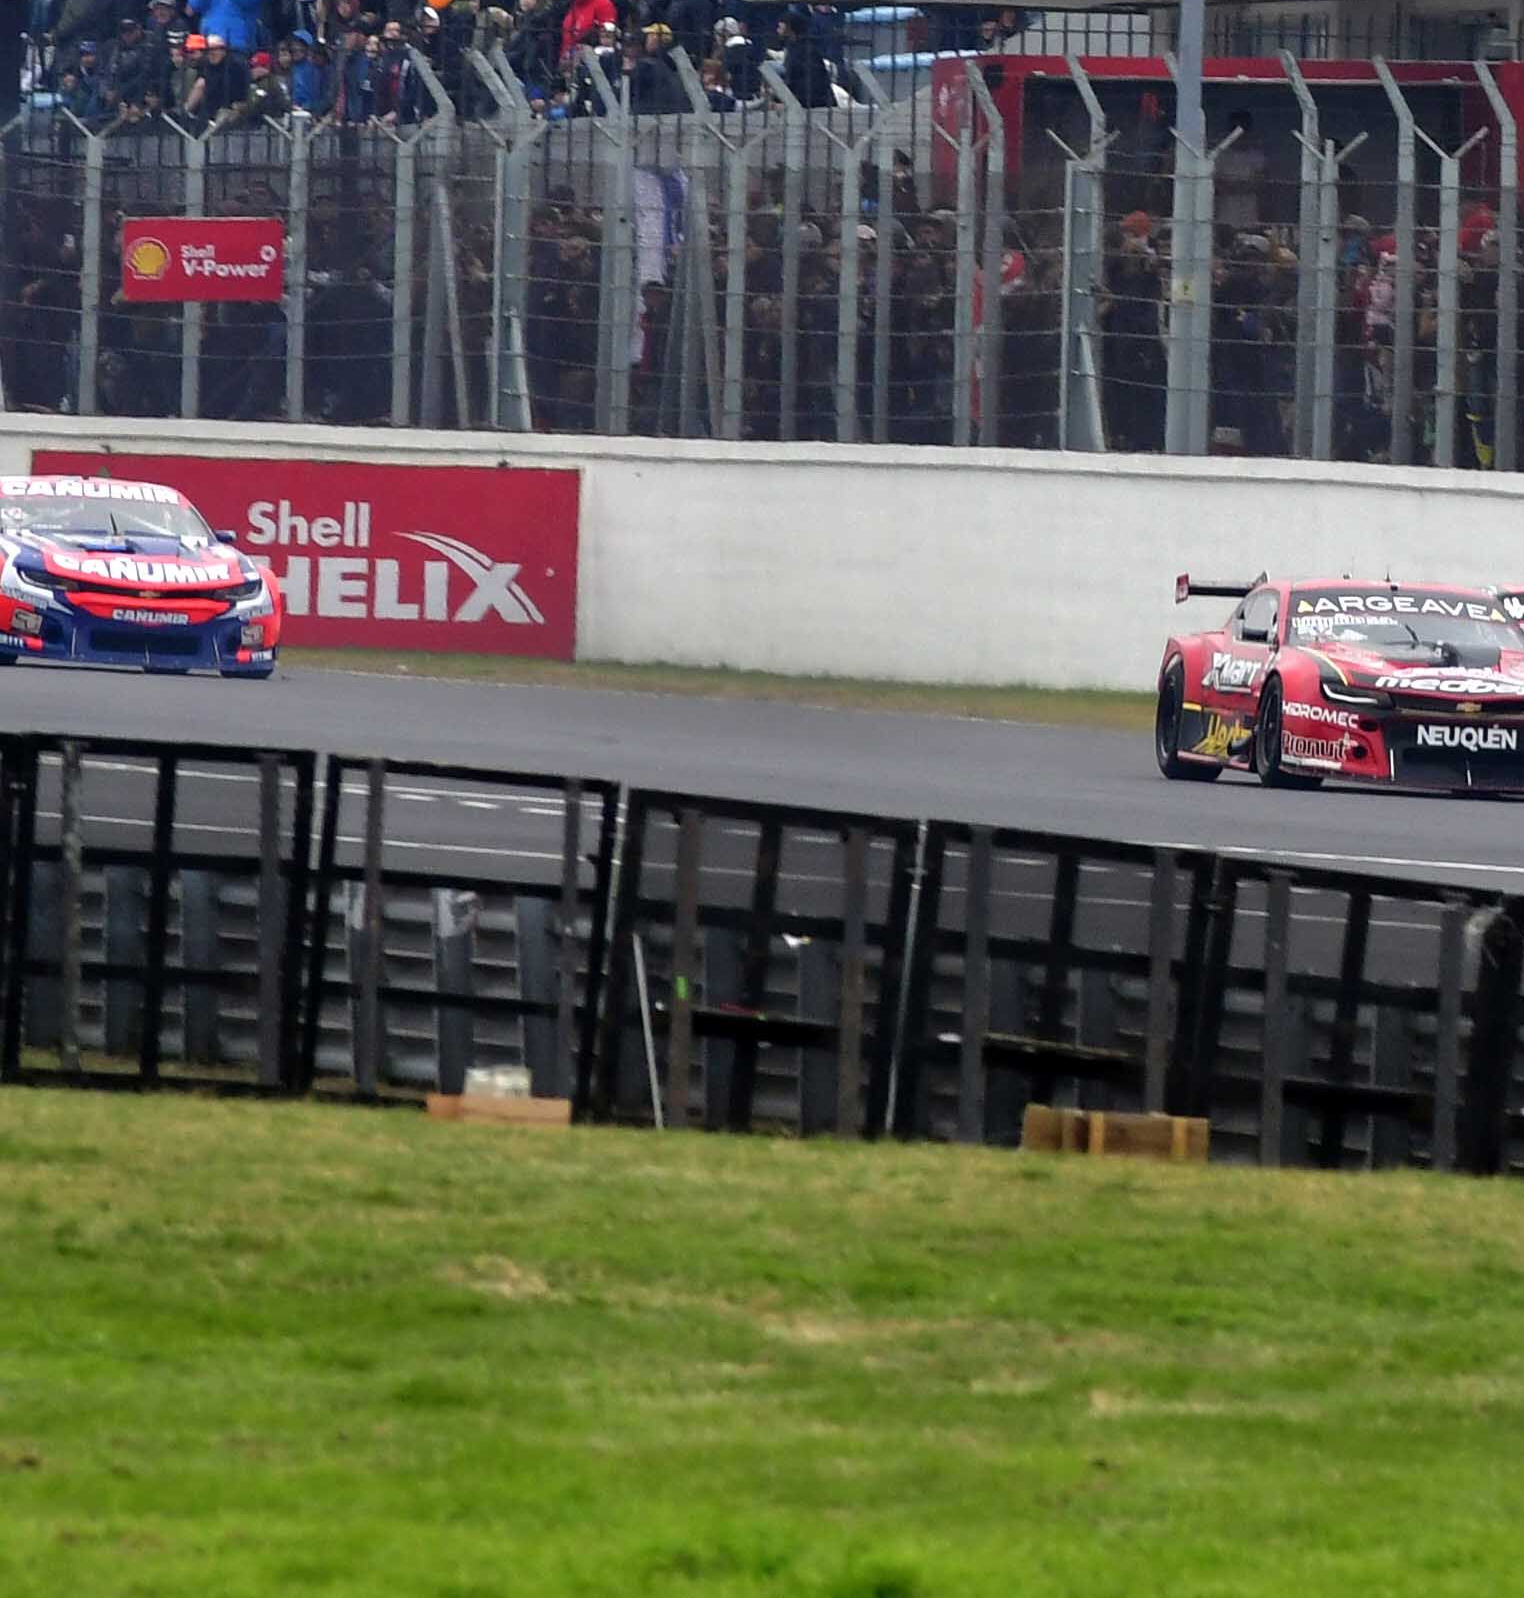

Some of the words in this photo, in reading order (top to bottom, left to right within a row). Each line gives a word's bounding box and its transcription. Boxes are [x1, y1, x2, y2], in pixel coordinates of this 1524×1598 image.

[182, 259, 270, 278] V-Power
[248, 501, 371, 547] Shell
[53, 553, 230, 584] CAÑUMIR
[1417, 722, 1517, 752] NEUQUÉN
